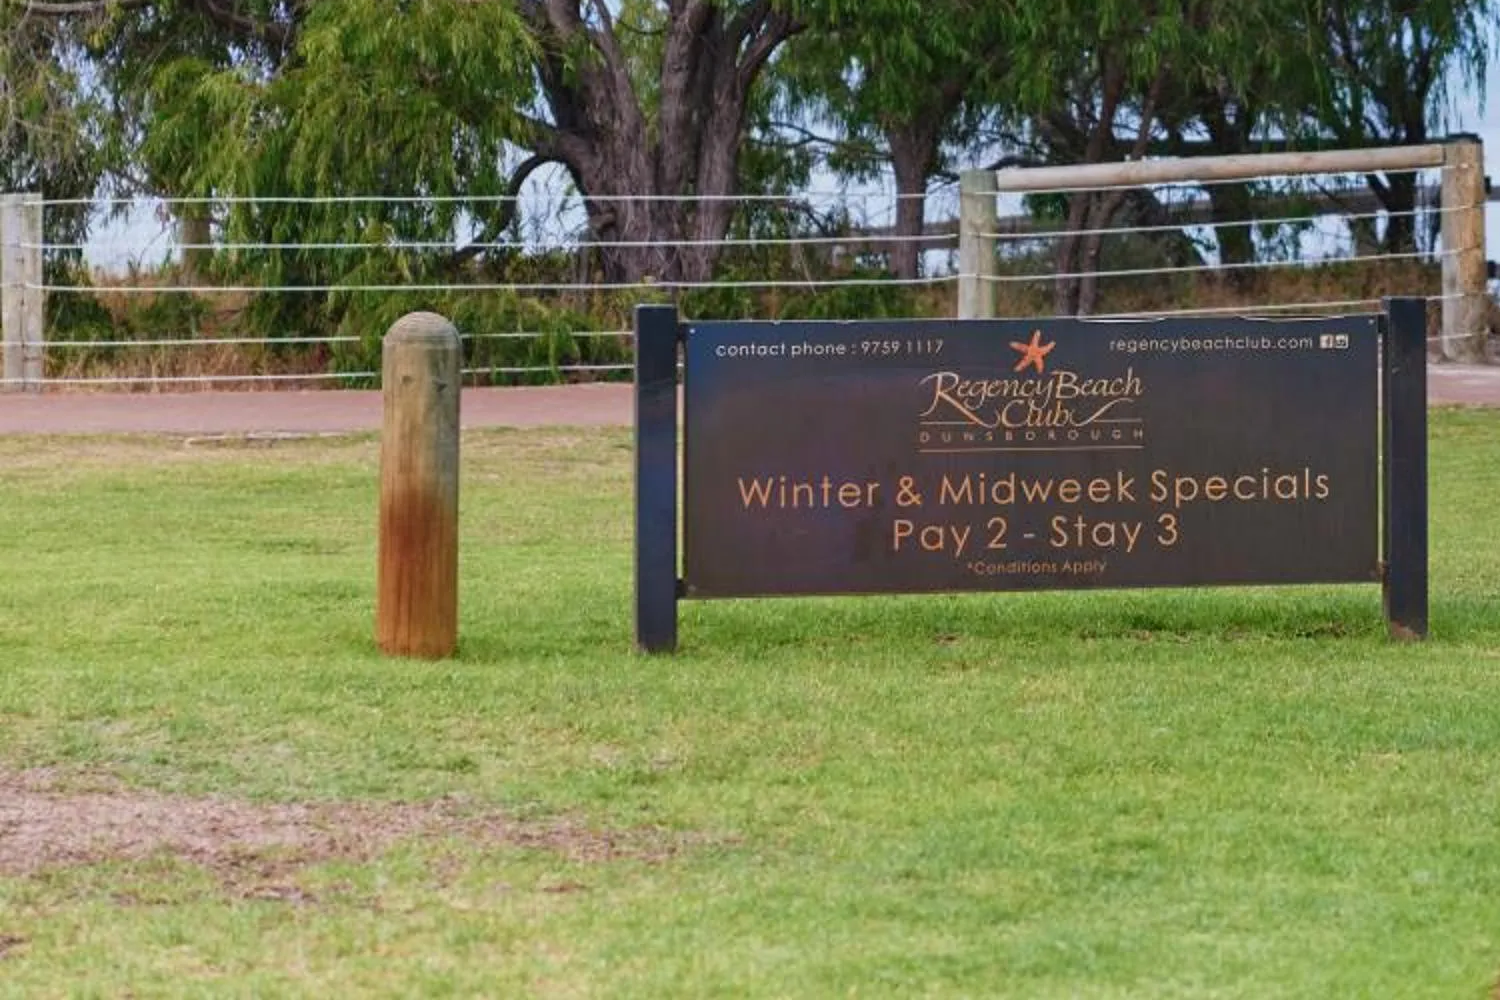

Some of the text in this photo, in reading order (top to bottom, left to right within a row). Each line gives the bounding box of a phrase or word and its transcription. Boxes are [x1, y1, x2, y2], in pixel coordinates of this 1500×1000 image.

[715, 341, 785, 358] contact
[791, 340, 846, 359] phone
[861, 340, 900, 356] 9759
[906, 339, 944, 354] 1117
[1109, 334, 1314, 353] regencybeachclub.com
[919, 366, 1144, 428] Regency Beach
[1000, 399, 1075, 428] Club
[919, 428, 1144, 444] DUNSBOROUGH
[737, 467, 1330, 508] Winter & Midweek Specials
[893, 519, 971, 557] Pay
[986, 517, 1008, 549] 2
[1050, 515, 1142, 553] Stay
[1157, 513, 1179, 546] 3
[1061, 558, 1108, 575] Apply
